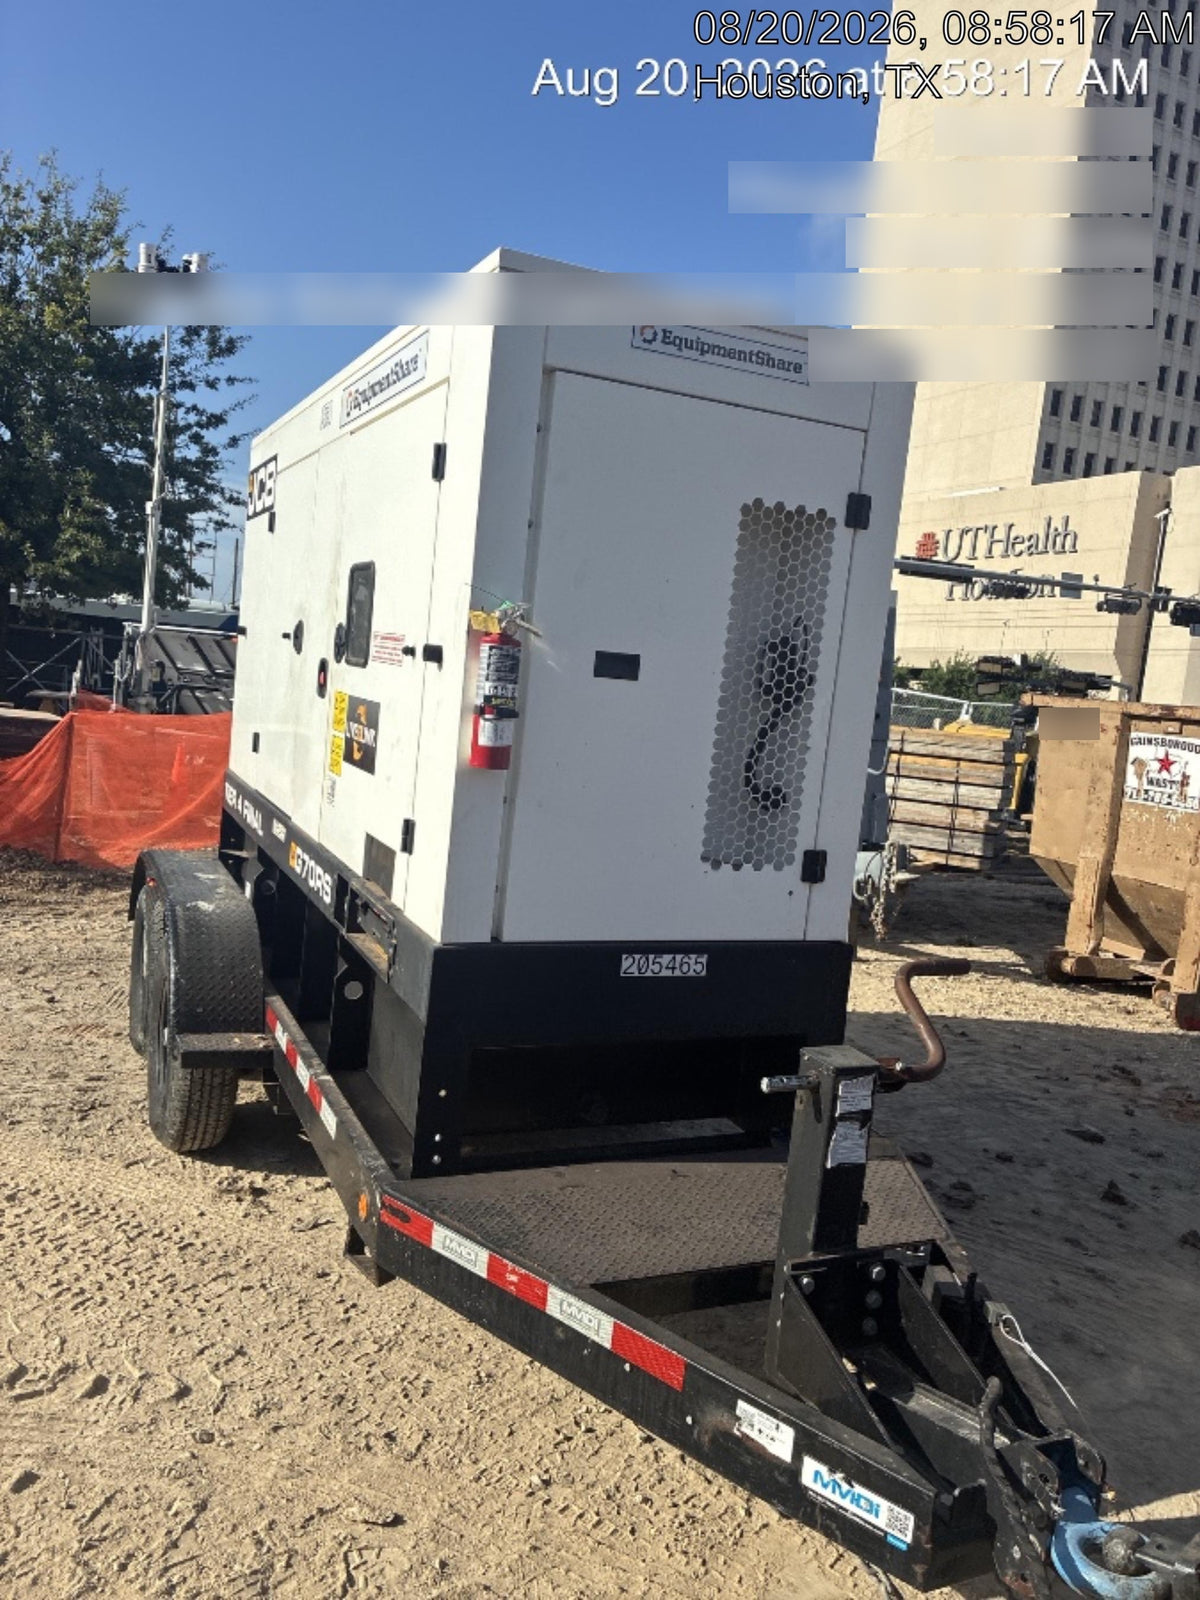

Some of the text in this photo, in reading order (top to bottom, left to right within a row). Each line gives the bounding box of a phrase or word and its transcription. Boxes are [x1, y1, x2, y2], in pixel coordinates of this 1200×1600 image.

[661, 328, 803, 374] EquipmentShare
[942, 515, 1078, 562] UTHealth
[622, 955, 705, 975] 205465
